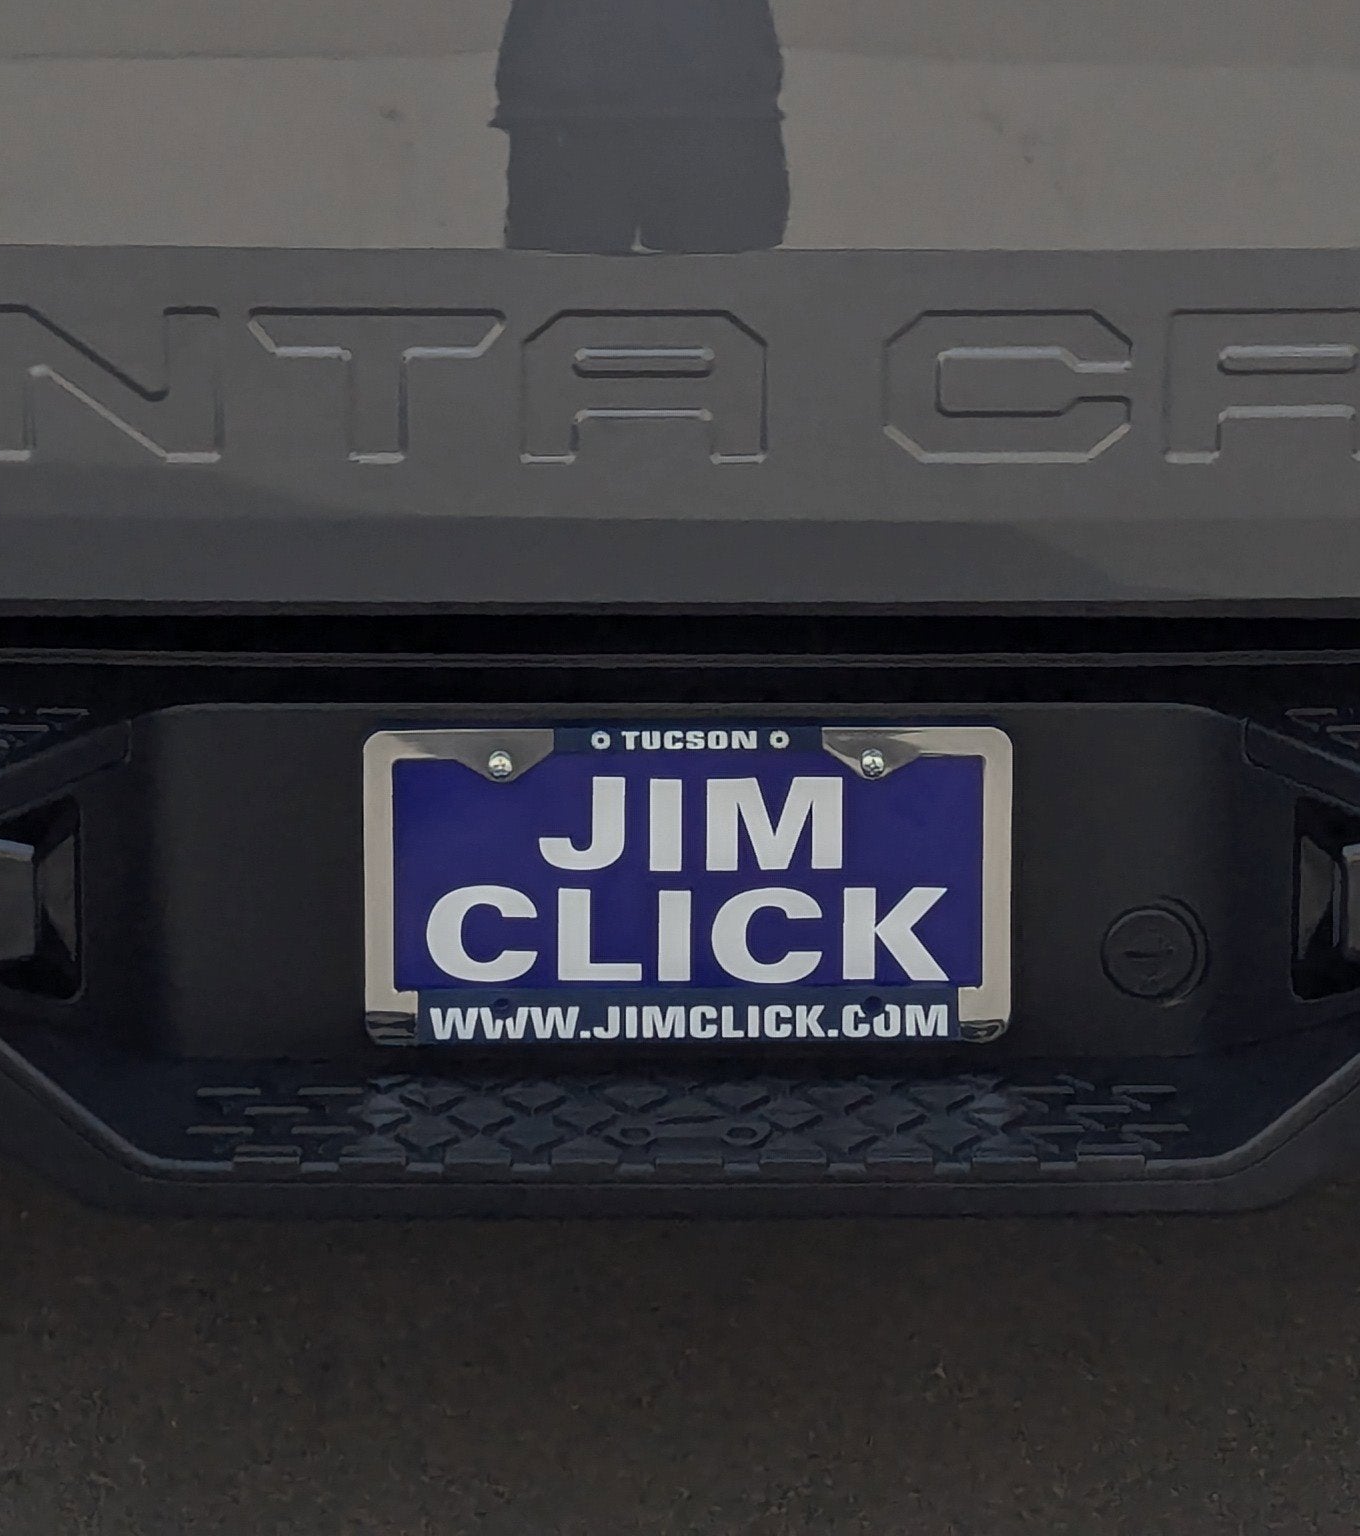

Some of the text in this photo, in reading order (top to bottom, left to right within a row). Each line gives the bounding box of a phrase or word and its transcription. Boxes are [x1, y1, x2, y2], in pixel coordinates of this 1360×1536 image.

[620, 730, 759, 751] TUCSON
[538, 775, 844, 873] JIM
[425, 885, 950, 984] CLICK
[429, 1003, 949, 1042] WWW.JIMCLICK.COM
